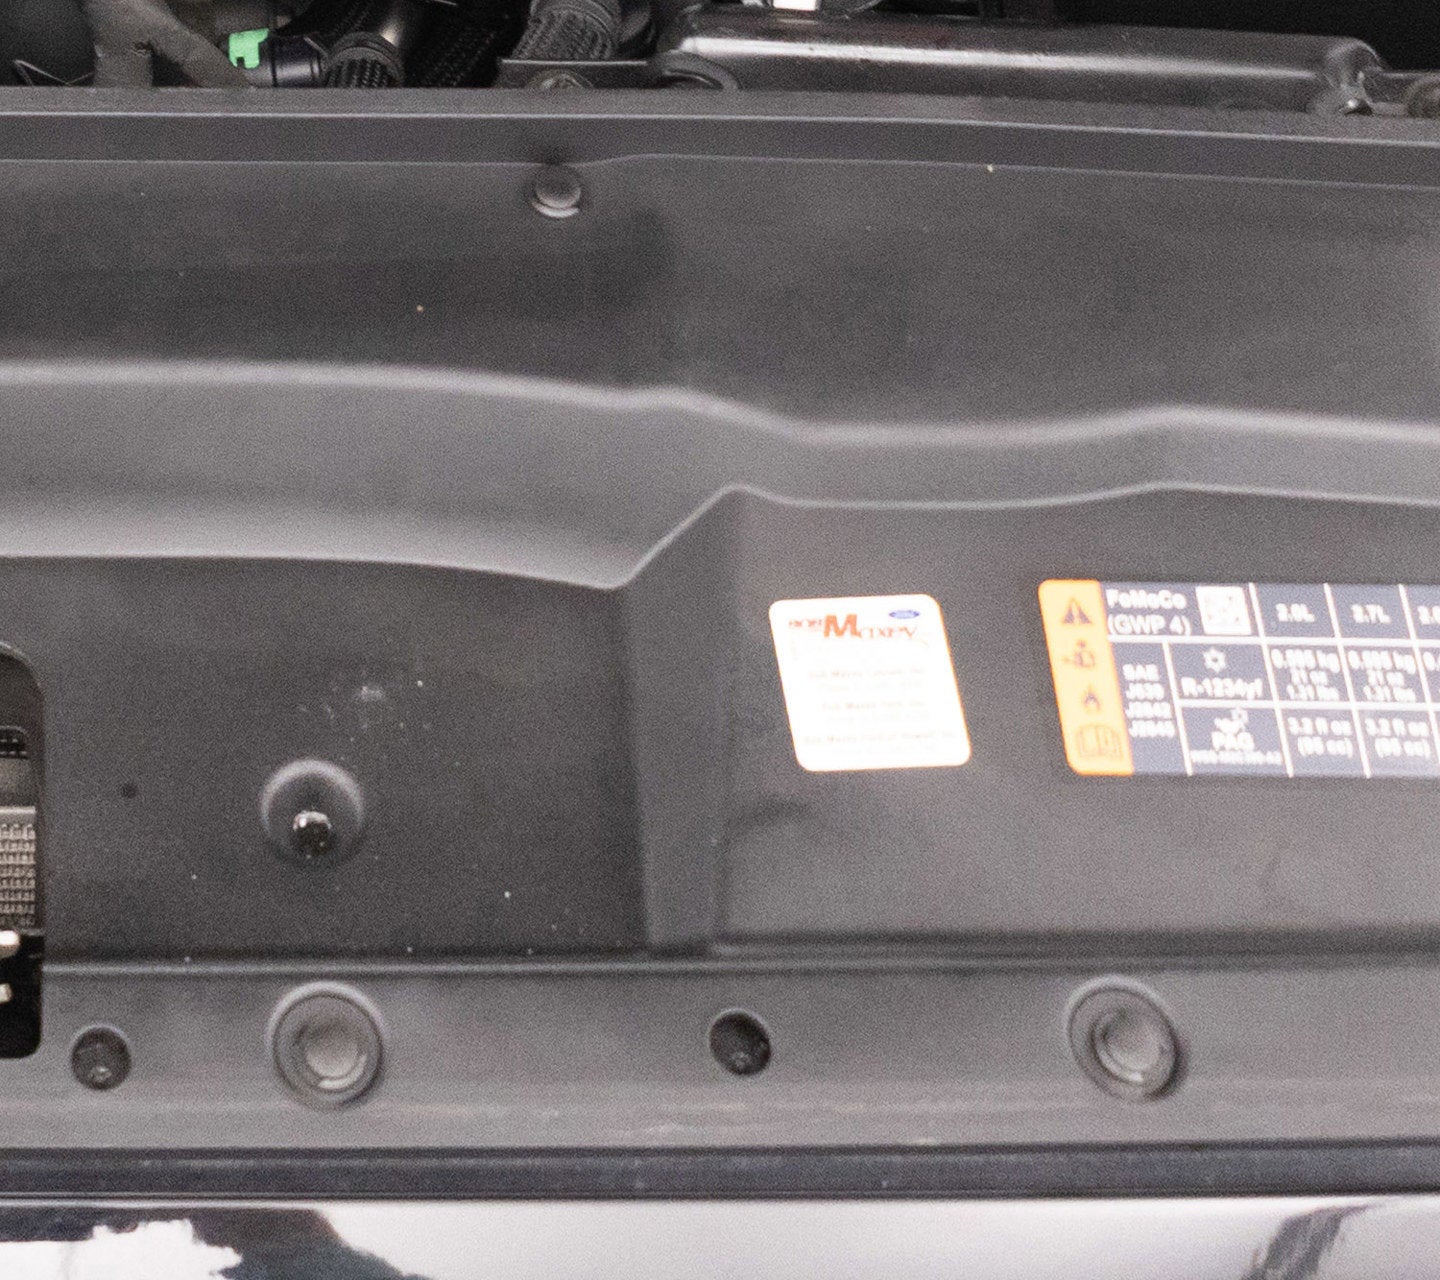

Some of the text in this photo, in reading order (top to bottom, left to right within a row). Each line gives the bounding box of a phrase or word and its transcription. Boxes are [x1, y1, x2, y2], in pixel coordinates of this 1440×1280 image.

[1105, 589, 1187, 609] FoMoCo
[1108, 614, 1192, 636] (GWP 4)
[1180, 676, 1263, 700] R-1234yf
